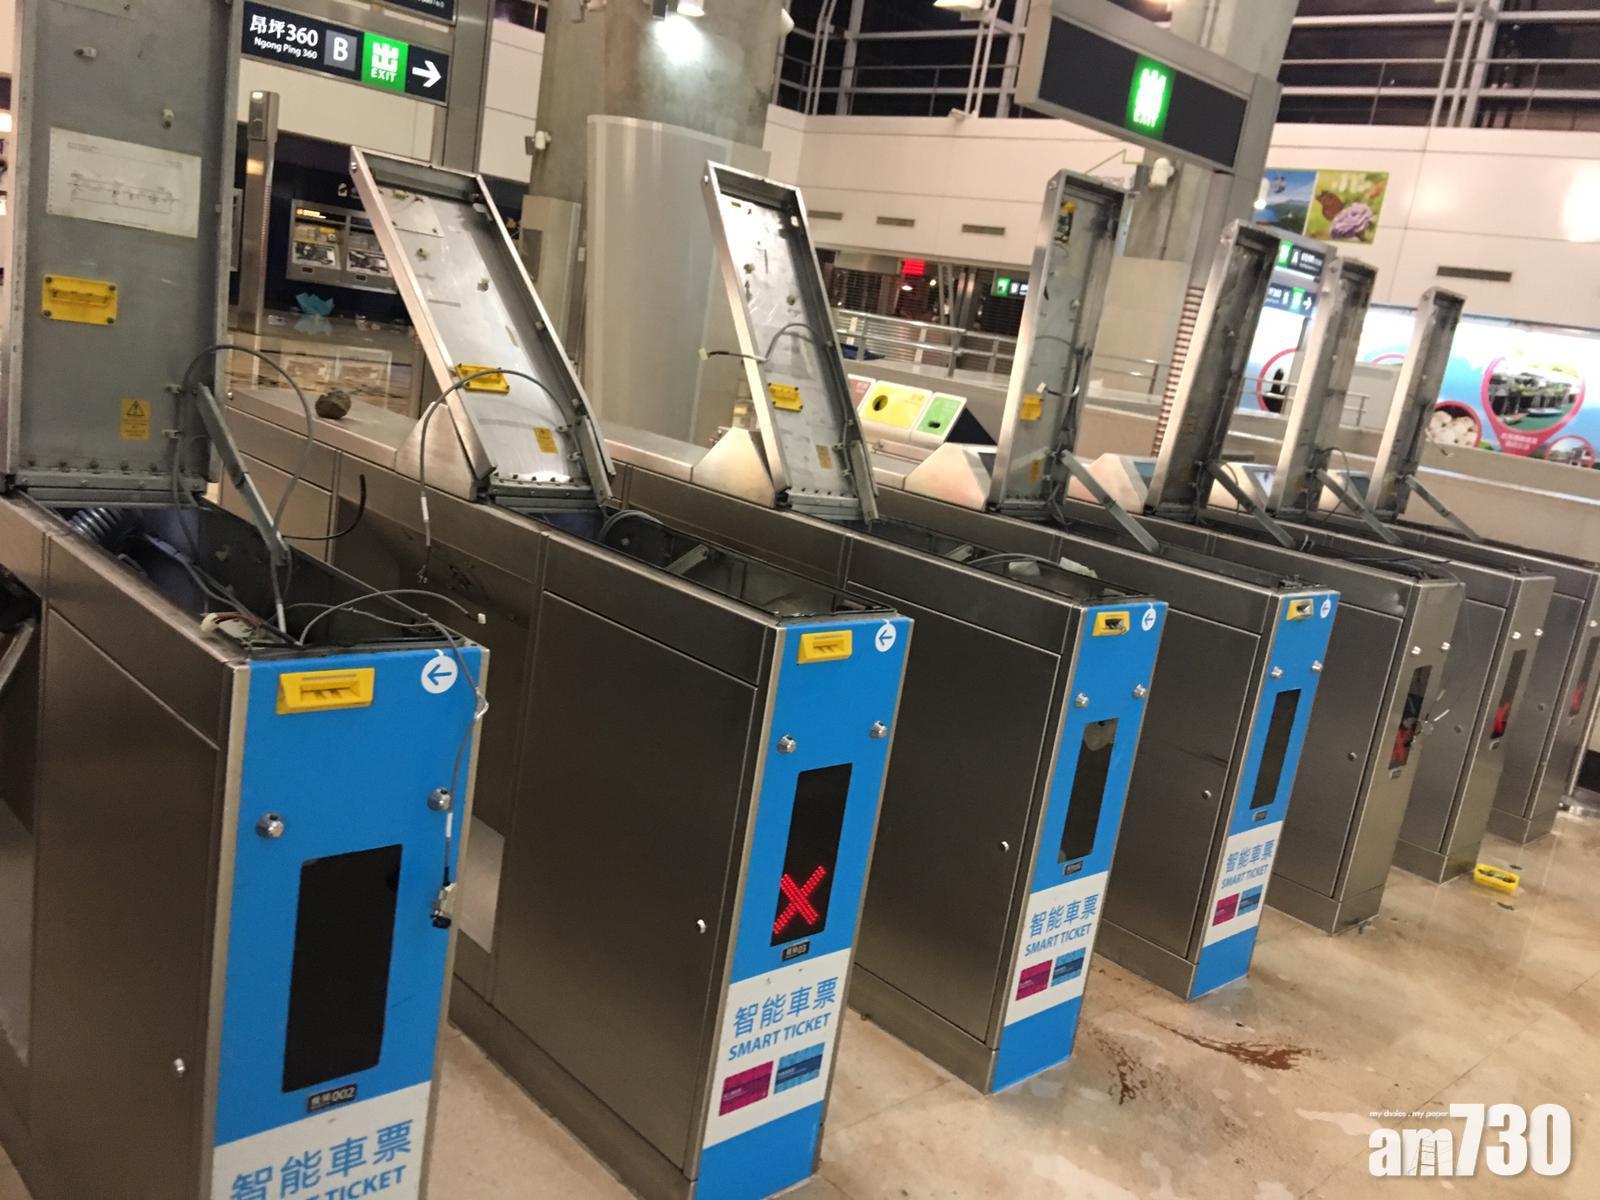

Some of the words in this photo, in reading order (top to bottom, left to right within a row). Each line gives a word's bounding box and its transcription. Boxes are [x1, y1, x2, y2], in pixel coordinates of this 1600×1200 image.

[250, 14, 319, 47] 昂坪360
[254, 36, 282, 53] Ngong
[283, 43, 302, 58] Ping
[302, 48, 318, 59] 360
[333, 37, 349, 61] B
[371, 67, 397, 82] EXIT
[1029, 894, 1099, 938] 智能車票
[1024, 934, 1060, 957] SMART
[1060, 923, 1092, 944] TICKET
[733, 976, 839, 1039] 智能車票
[728, 1031, 781, 1061] SMART
[784, 1012, 832, 1041] TICKET
[230, 1119, 414, 1200] 智能車票
[324, 1165, 407, 1200] TICKET
